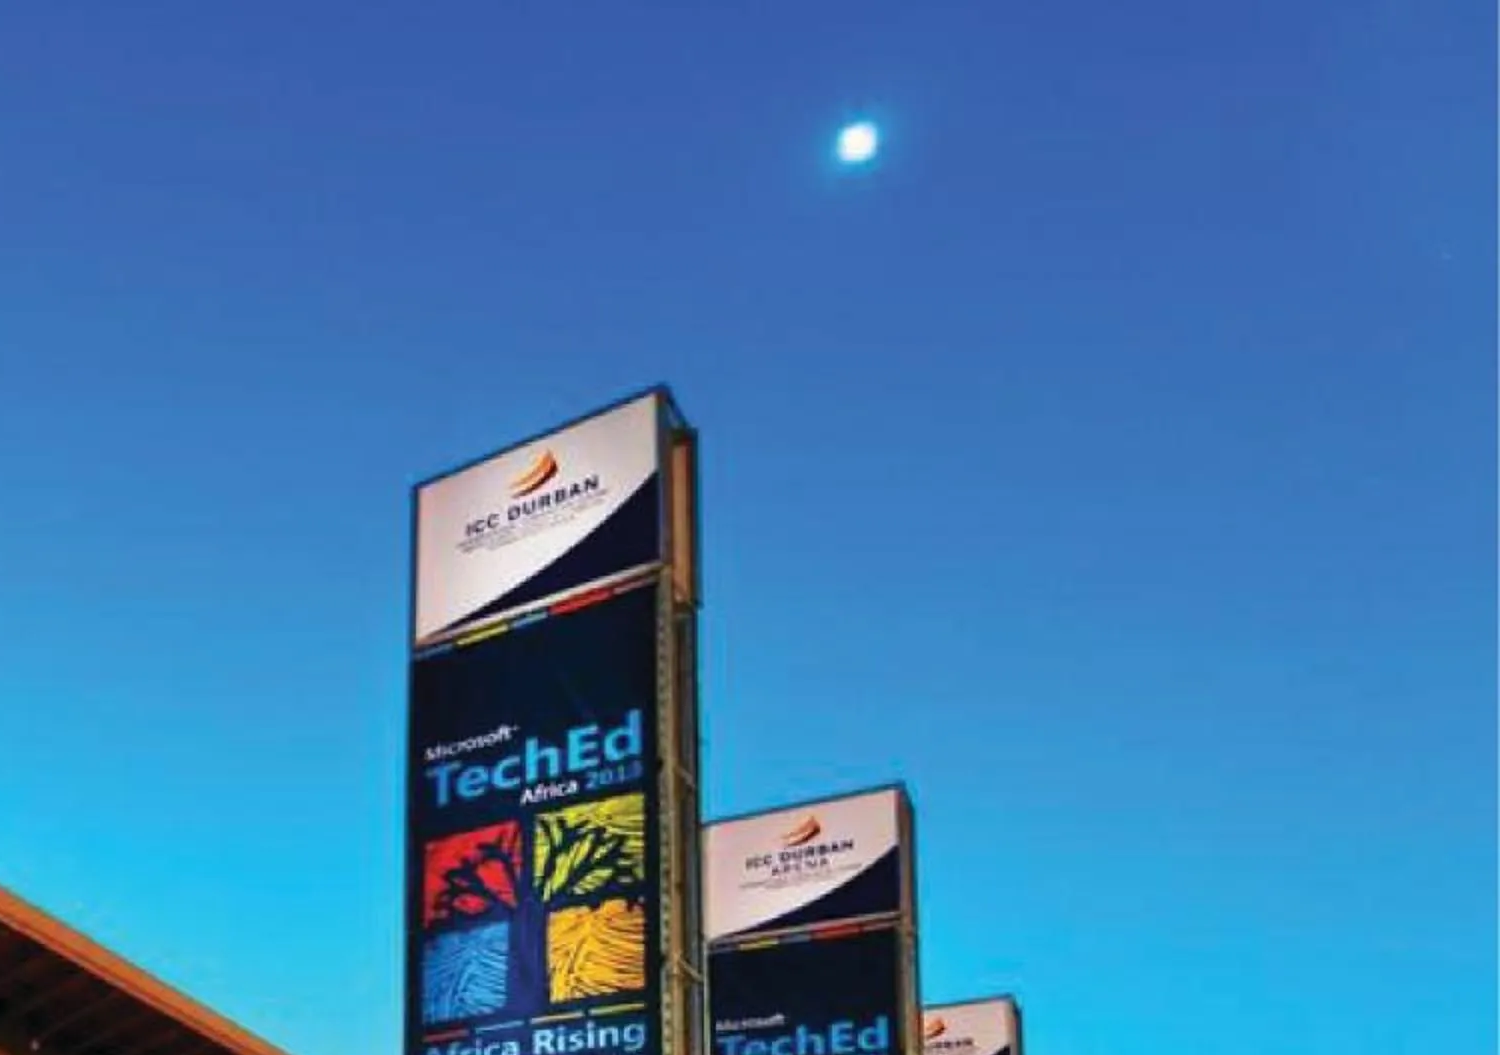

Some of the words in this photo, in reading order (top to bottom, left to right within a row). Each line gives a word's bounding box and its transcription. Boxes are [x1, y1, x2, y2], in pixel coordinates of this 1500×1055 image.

[465, 513, 500, 536] ICC
[507, 474, 599, 521] DURBAN
[426, 708, 642, 807] TechEd
[519, 780, 579, 806] Africa
[745, 854, 773, 870] ICC
[533, 1021, 646, 1055] Rising
